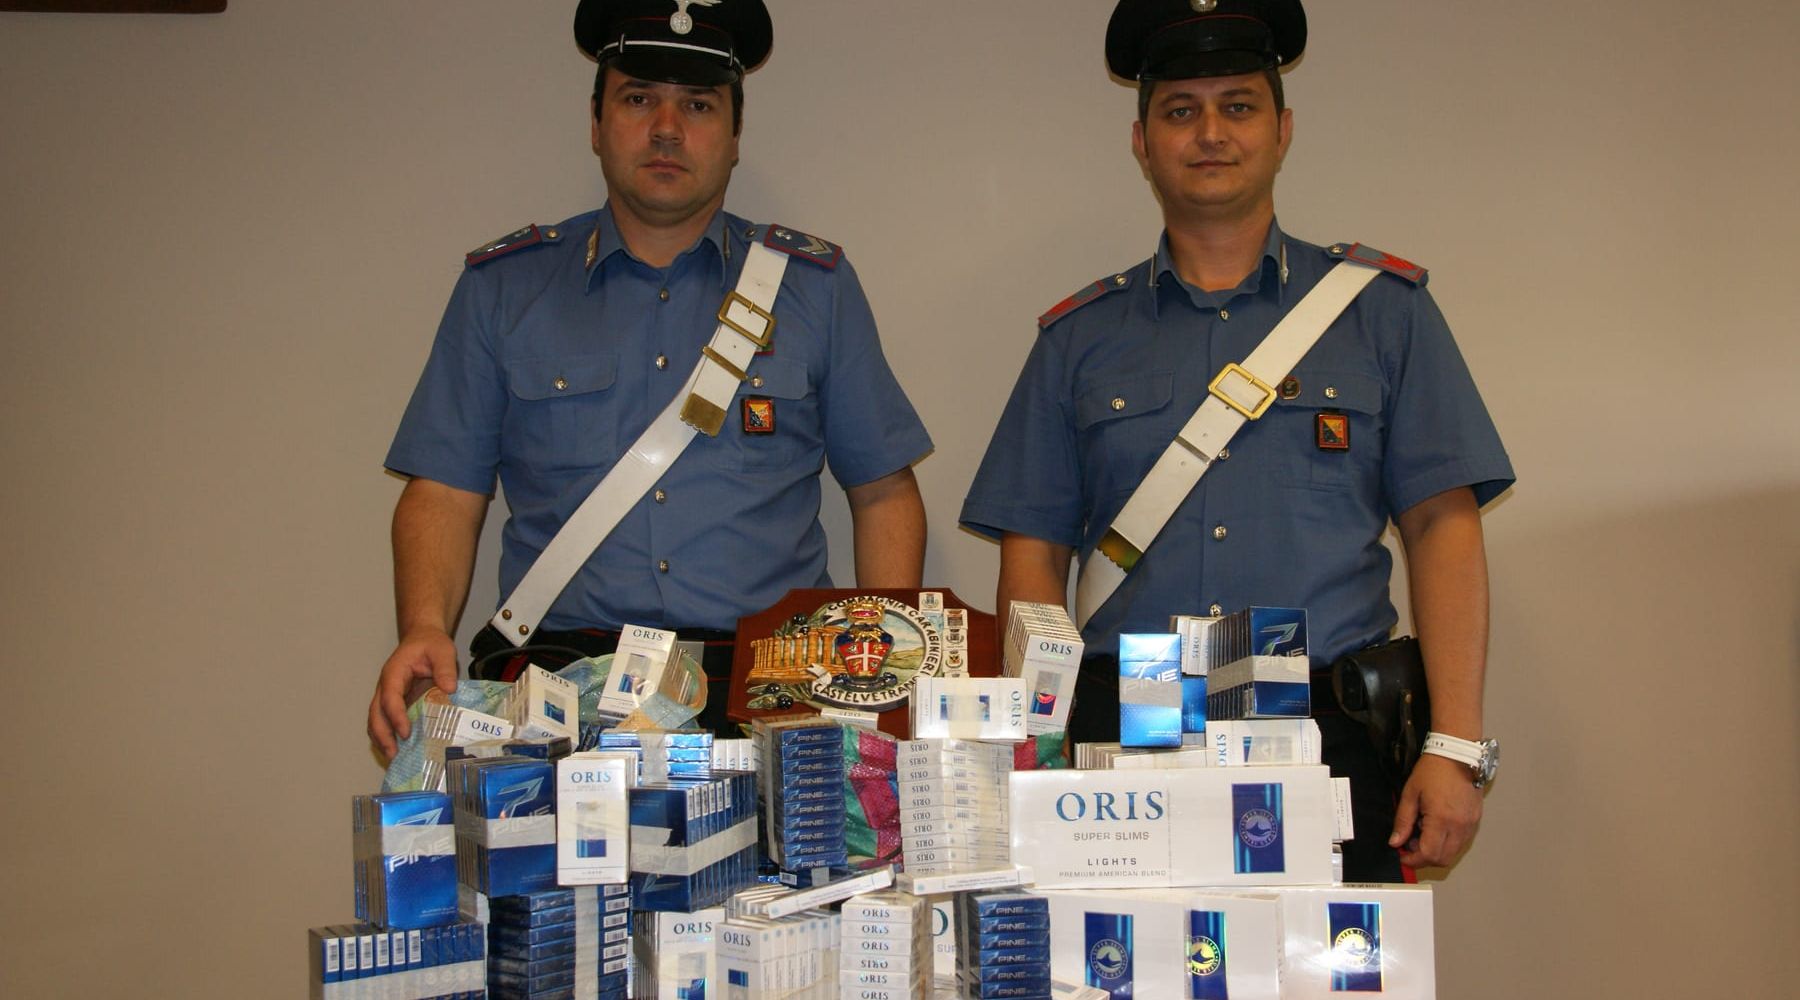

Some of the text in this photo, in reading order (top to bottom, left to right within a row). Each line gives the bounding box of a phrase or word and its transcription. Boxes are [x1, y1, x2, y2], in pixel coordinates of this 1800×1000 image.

[633, 628, 664, 641] ORIS
[909, 610, 941, 676] CARABINIERI
[1039, 641, 1073, 655] ORIS
[541, 670, 570, 687] ORIS
[1010, 690, 1022, 728] ORIS
[471, 720, 503, 736] ORIS
[798, 734, 822, 742] PINE
[798, 748, 822, 756] PINE
[910, 743, 928, 752] ORIS
[798, 762, 823, 770] PINE
[910, 757, 928, 766] ORIS
[571, 771, 612, 784] ORIS
[910, 770, 928, 780] ORIS
[799, 777, 824, 786] PINE
[912, 784, 930, 793] ORIS
[798, 791, 824, 799] PINE
[912, 798, 930, 806] ORIS
[1055, 790, 1164, 822] ORIS
[800, 805, 824, 813] PINE
[912, 812, 930, 820] ORIS
[800, 819, 824, 827] PINE
[914, 824, 932, 833] ORIS
[799, 832, 824, 840] PINE
[1073, 831, 1150, 841] SUPER SLIMS
[916, 838, 934, 848] ORIS
[800, 846, 825, 854] PINE
[916, 852, 935, 861] ORIS
[801, 860, 826, 868] PINE
[1087, 857, 1137, 866] LIGHTS
[862, 908, 890, 918] ORIS
[996, 906, 1024, 914] PINE
[673, 921, 712, 935] ORIS
[862, 925, 889, 934] ORIS
[998, 922, 1025, 930] PINE
[723, 931, 751, 947] ORIS
[998, 939, 1026, 947] PINE
[862, 941, 889, 950] ORIS
[998, 954, 1026, 962] PINE
[860, 960, 888, 968] ORIS
[859, 974, 888, 984] ORIS
[998, 972, 1026, 980] PINE
[861, 990, 889, 1000] ORIS
[998, 988, 1026, 996] PINE
